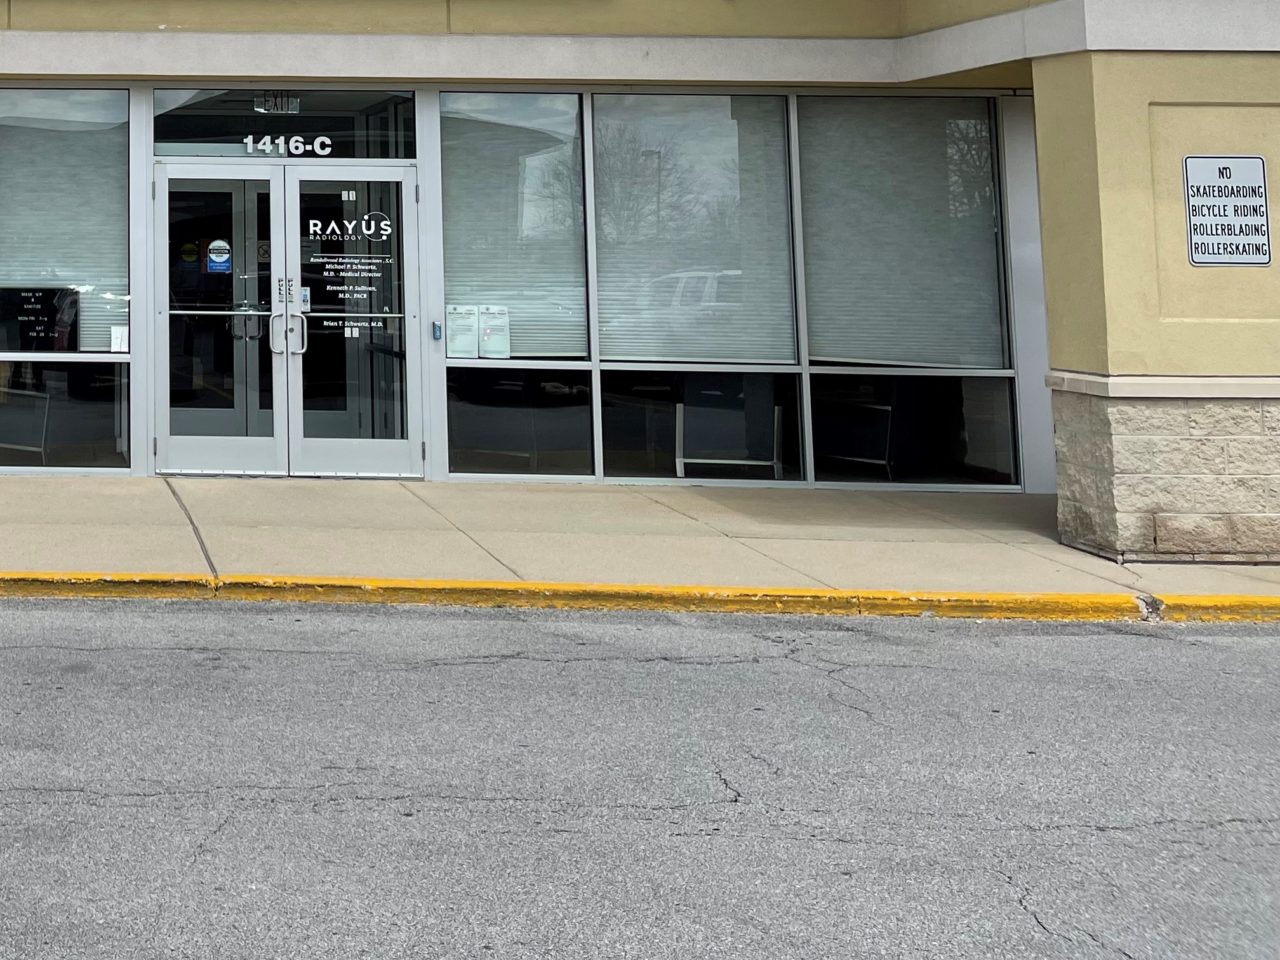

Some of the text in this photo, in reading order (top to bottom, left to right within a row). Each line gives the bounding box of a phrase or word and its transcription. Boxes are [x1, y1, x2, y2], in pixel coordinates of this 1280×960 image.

[243, 135, 332, 155] 1416-C
[1218, 167, 1232, 179] NO
[1190, 185, 1263, 198] SKATEBOARDING
[1192, 205, 1265, 217] BICYCLE RIDING
[309, 219, 392, 235] RAYUS
[1193, 224, 1266, 237] ROLLERBLADING
[1194, 243, 1267, 256] ROLLERSKATING
